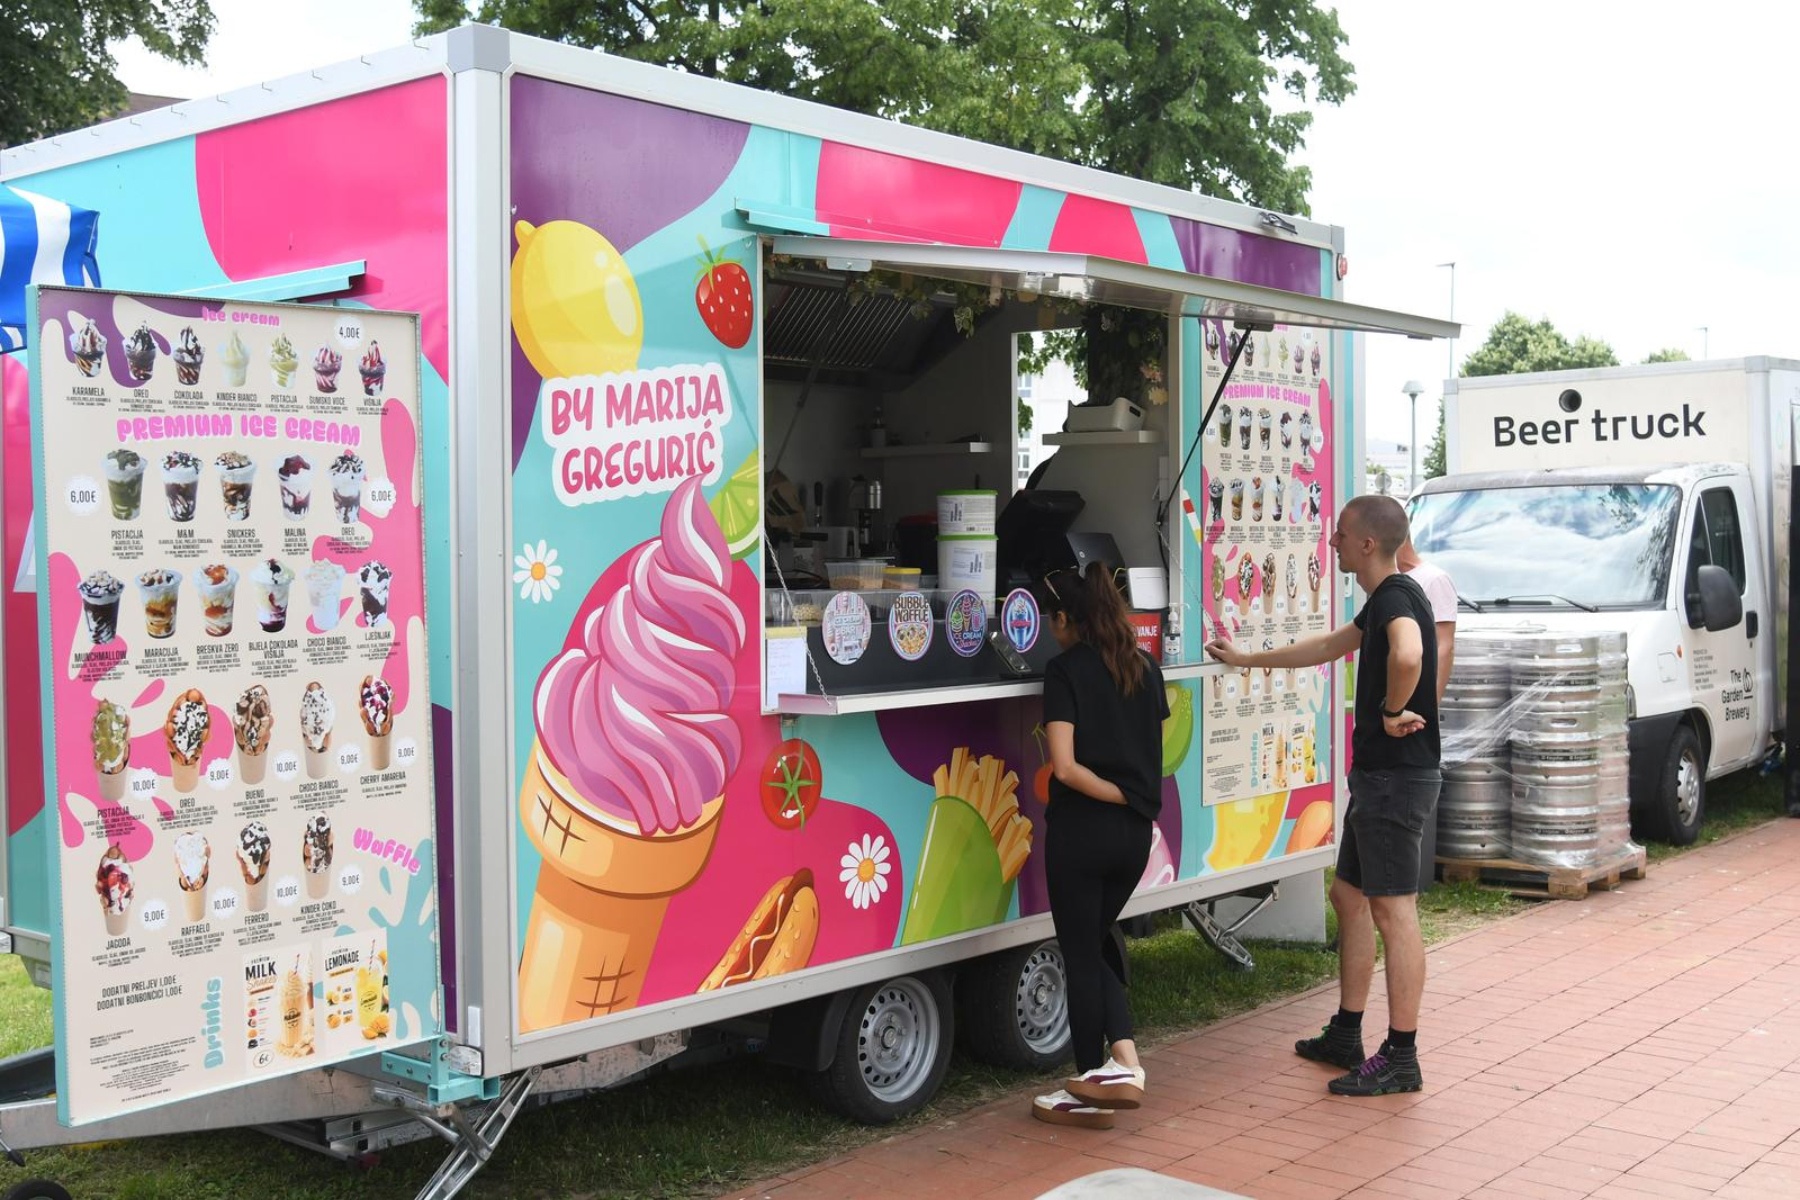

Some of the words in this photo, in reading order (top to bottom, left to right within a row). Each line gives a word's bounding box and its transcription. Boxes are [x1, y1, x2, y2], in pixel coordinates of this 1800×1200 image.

[202, 305, 226, 322] Ice
[232, 311, 280, 326] cream
[339, 326, 360, 340] 4,00€
[72, 387, 105, 398] KARAMELA
[134, 389, 149, 399] OREO
[217, 392, 237, 402] KINDER
[238, 394, 257, 403] BIANCO
[1223, 384, 1263, 399] PREMIUM
[271, 395, 297, 404] PISTACIJA
[551, 387, 594, 436] BY
[606, 374, 724, 428] MARIJA
[117, 414, 233, 443] PREMIUM
[241, 414, 276, 438] ICE
[284, 417, 360, 447] CREAM
[1494, 415, 1579, 447] Beer
[1591, 404, 1706, 442] truck
[561, 418, 716, 495] GREGURIĆ
[70, 490, 96, 504] 6,00€
[371, 490, 392, 502] 6,00€
[111, 530, 144, 541] PISTACIJA
[177, 530, 194, 540] M&M
[227, 529, 256, 540] SNICKERS
[285, 528, 306, 538] MALINA
[341, 527, 355, 537] OREO
[249, 641, 268, 652] BIJELA
[307, 638, 326, 648] CHOCO
[326, 636, 346, 646] BIANCO
[145, 648, 178, 659] MARACUJA
[197, 644, 223, 656] BRESKVA
[224, 643, 239, 654] ZERO
[74, 651, 127, 663] MUNCHMALLOW
[1730, 669, 1741, 684] The
[1722, 687, 1744, 704] Garden
[1726, 706, 1750, 721] Brewery
[276, 761, 297, 773] 10,00€
[210, 770, 229, 781] 9,00€
[360, 773, 381, 785] CHERRY
[381, 771, 406, 782] AMARENA
[133, 779, 155, 791] 10,00€
[299, 781, 318, 793] CHOCO
[318, 779, 338, 790] BIANCO
[245, 789, 265, 800] BUENO
[180, 798, 195, 808] OREO
[97, 806, 130, 819] PISTACIJA
[353, 827, 421, 874] Waffle
[276, 885, 297, 898] 10,00€
[214, 897, 235, 910] 10,00€
[300, 903, 321, 914] KINDER
[144, 909, 165, 922] 9,00€
[244, 913, 269, 925] FERRERO
[181, 923, 210, 936] RAFFAELO
[106, 937, 131, 950] JAGODA
[325, 950, 359, 971] LEMONADE
[245, 961, 277, 981] MILK
[102, 984, 130, 998] DODATNI
[131, 979, 158, 993] PRELJEV
[97, 996, 125, 1011] DODATNI
[200, 979, 224, 1069] Drinks
